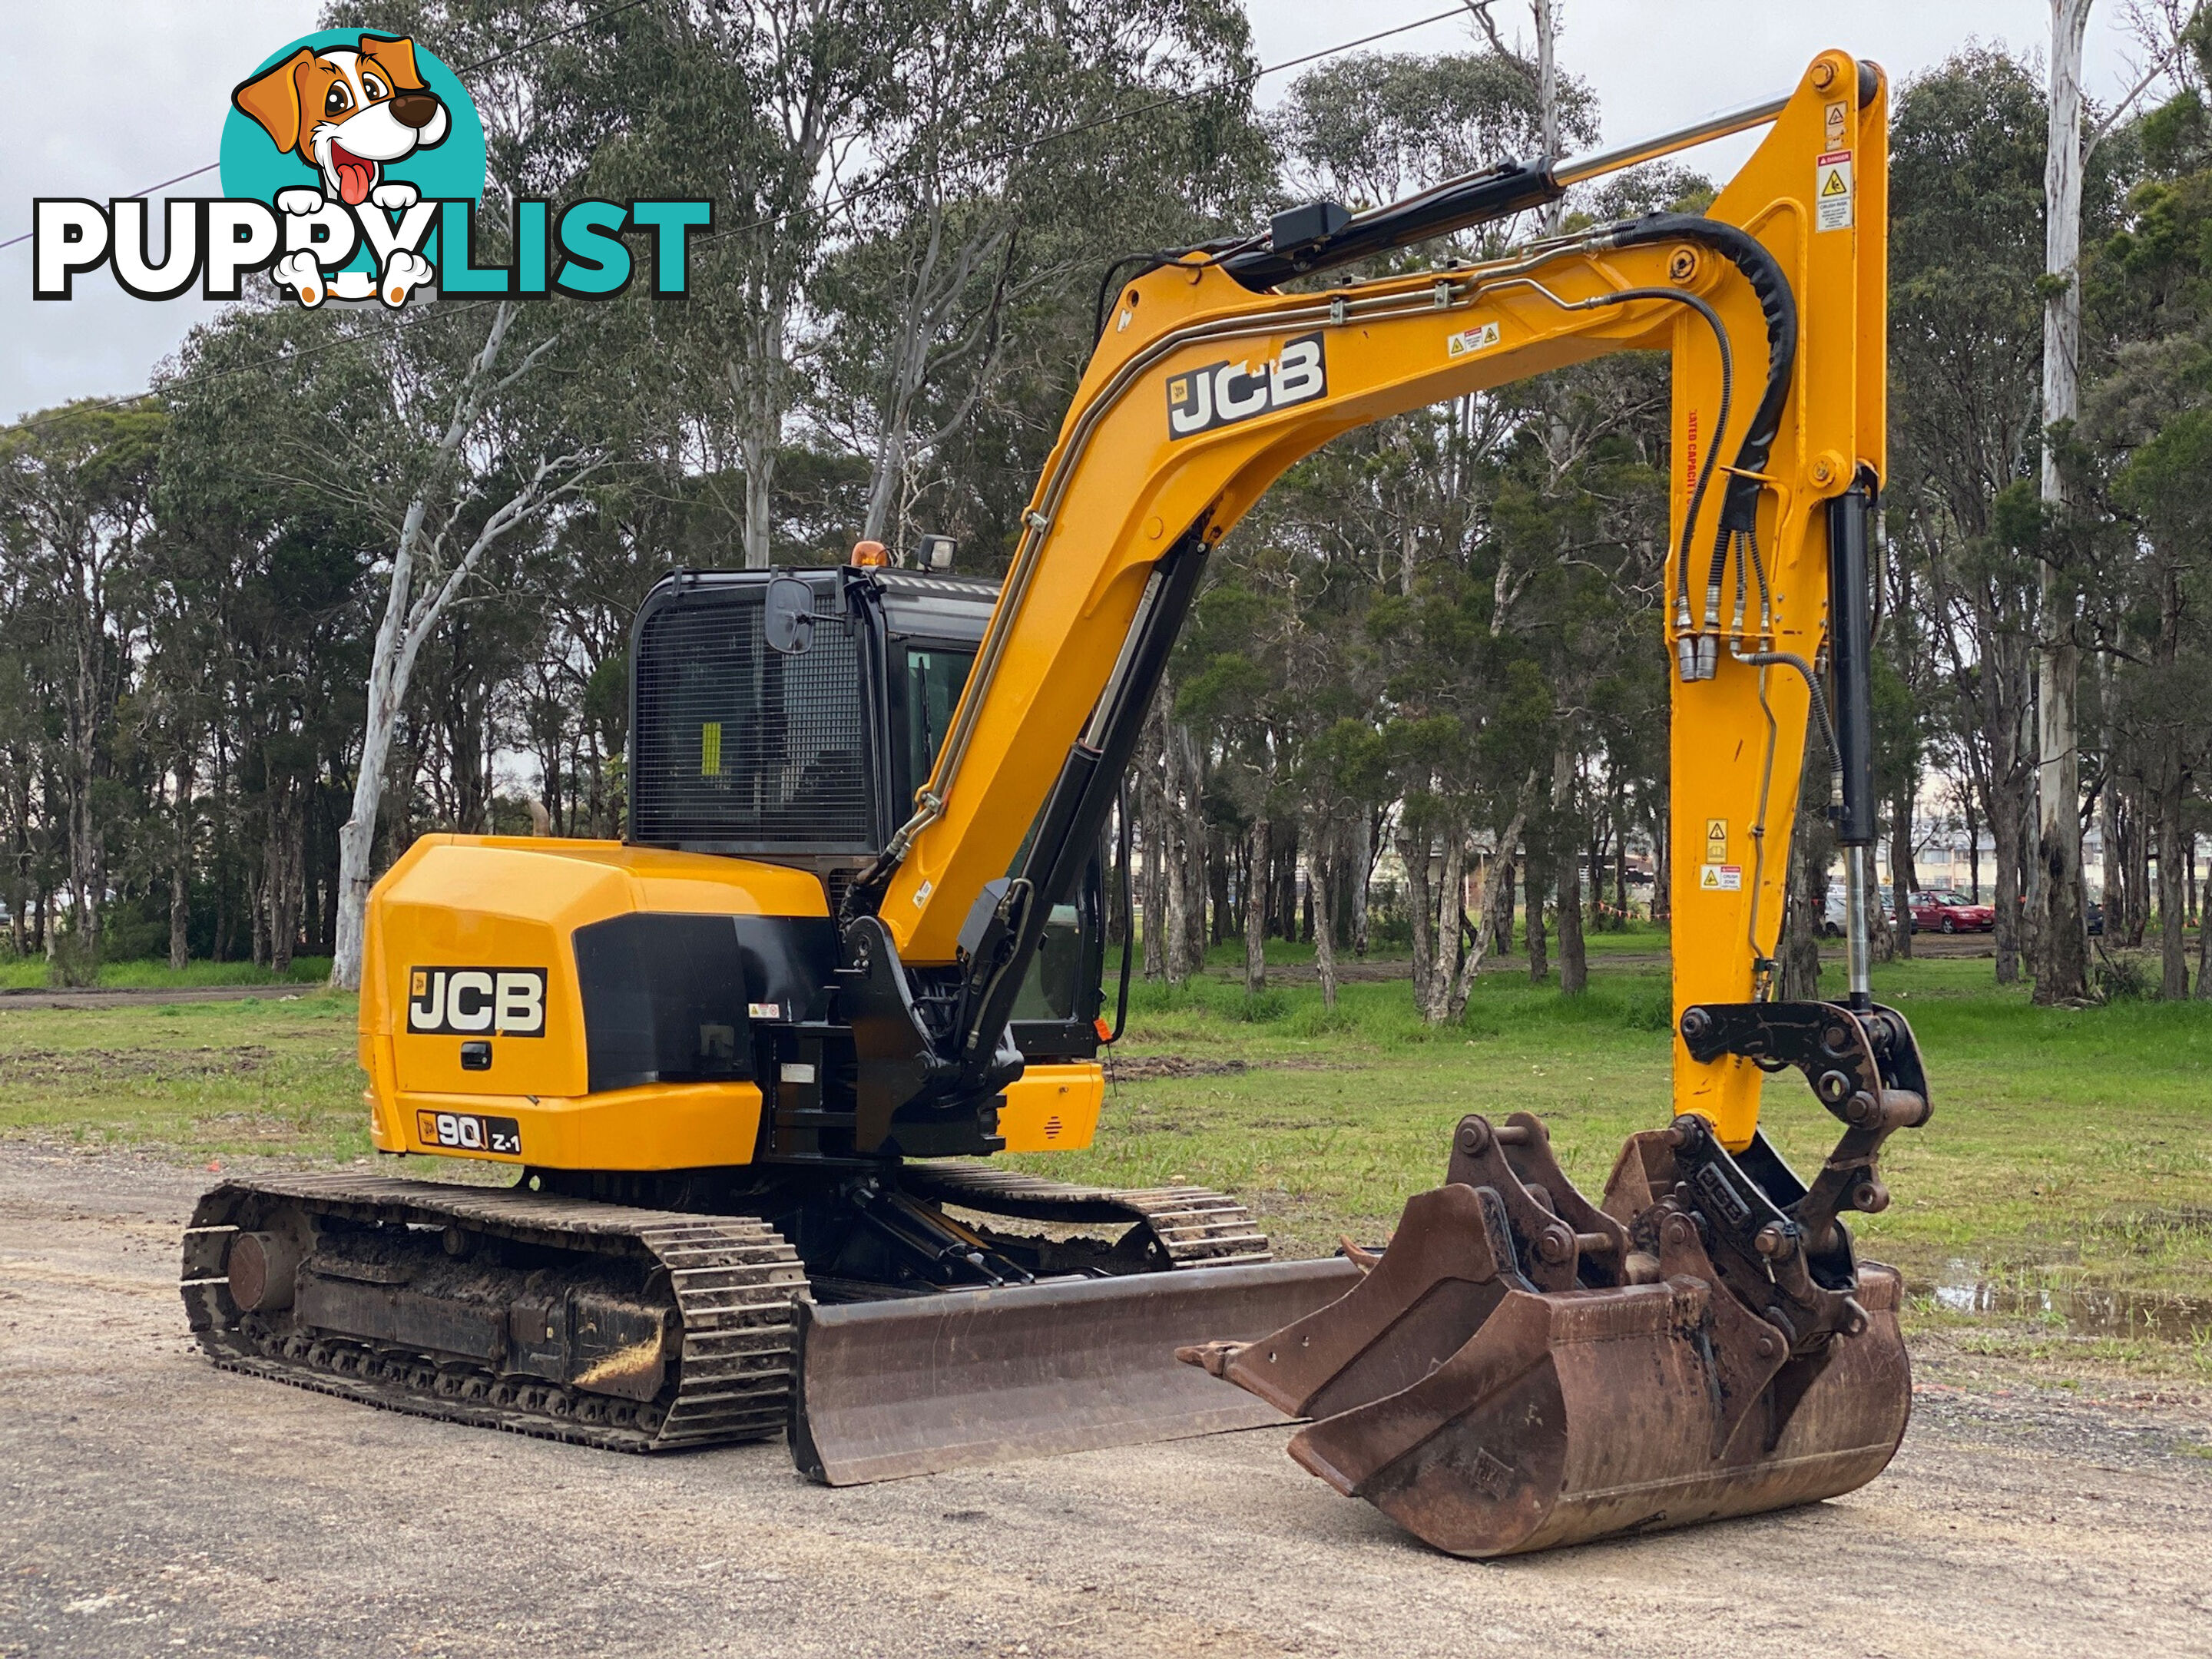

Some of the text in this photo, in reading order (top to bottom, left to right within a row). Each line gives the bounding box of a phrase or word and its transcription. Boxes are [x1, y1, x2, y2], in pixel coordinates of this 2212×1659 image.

[1172, 340, 1323, 432] JCB
[1688, 409, 1697, 441] ATED
[410, 972, 542, 1031] JCB
[437, 1114, 481, 1147] 90
